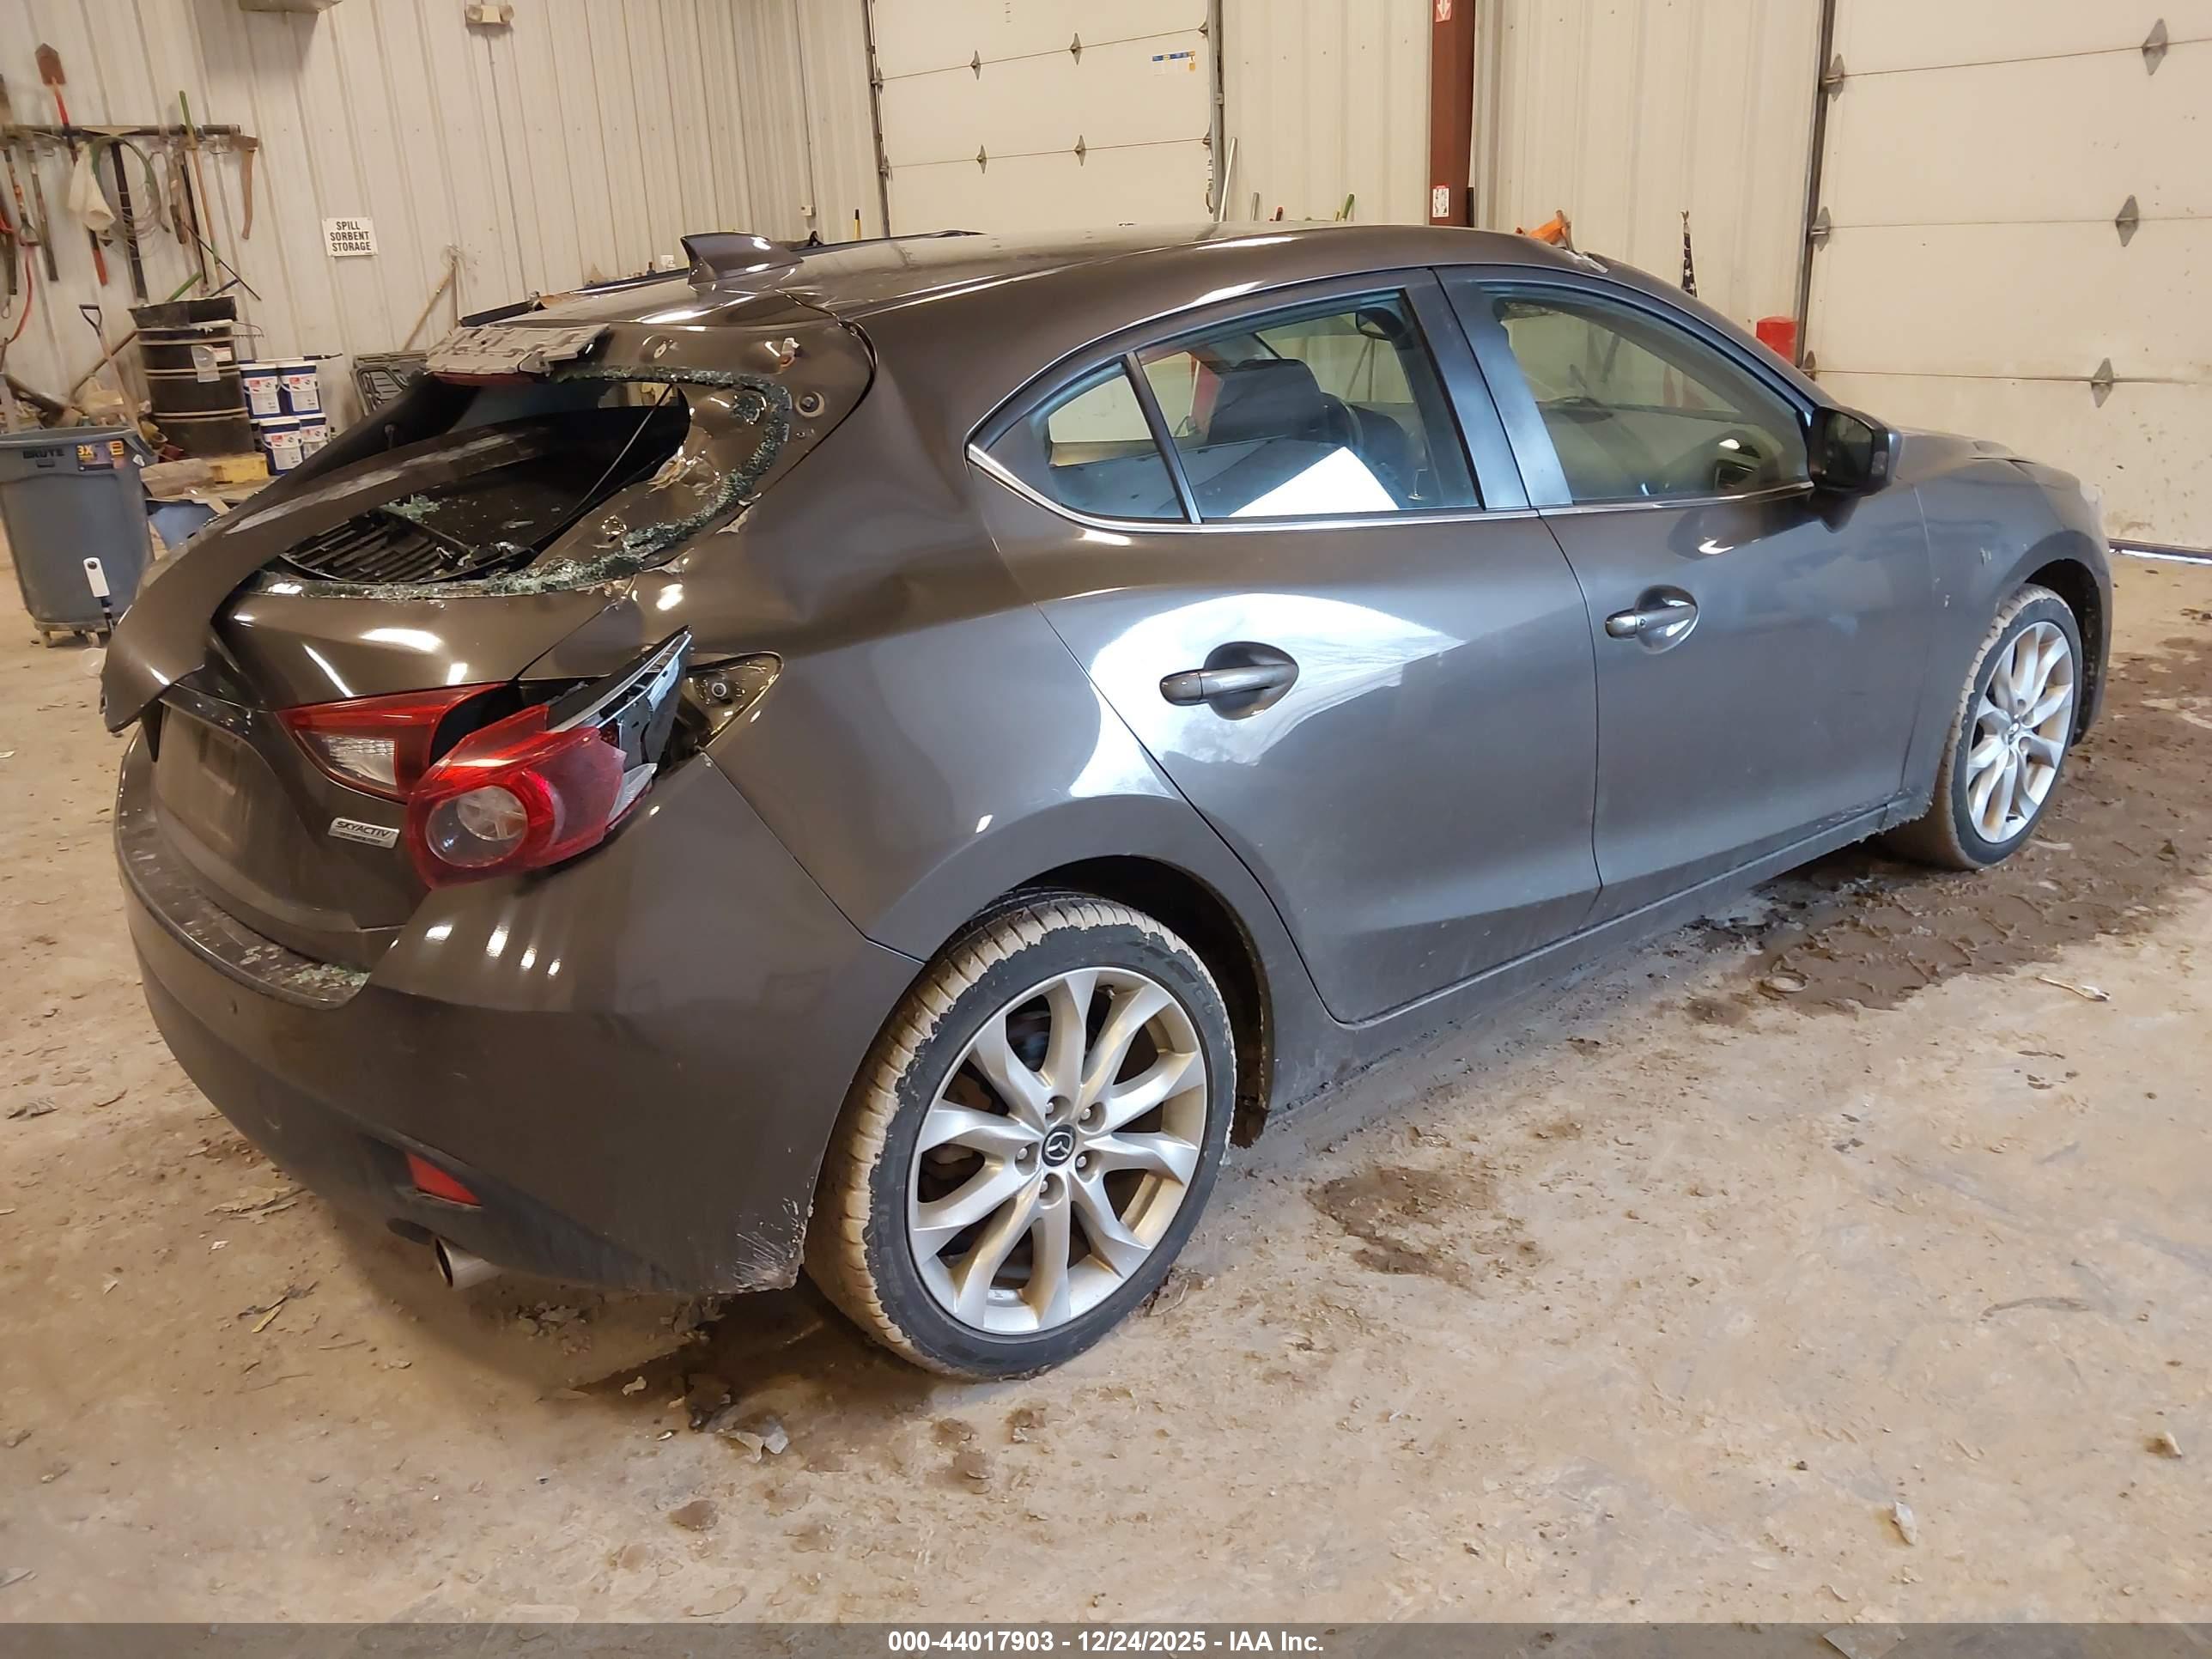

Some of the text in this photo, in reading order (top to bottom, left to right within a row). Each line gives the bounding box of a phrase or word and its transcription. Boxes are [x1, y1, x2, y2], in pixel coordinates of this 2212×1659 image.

[336, 221, 361, 231] SPILL
[330, 231, 369, 241] SORBENT
[331, 241, 372, 252] STORAGE
[76, 445, 94, 456] 3X
[336, 821, 391, 837] SKYACTIV
